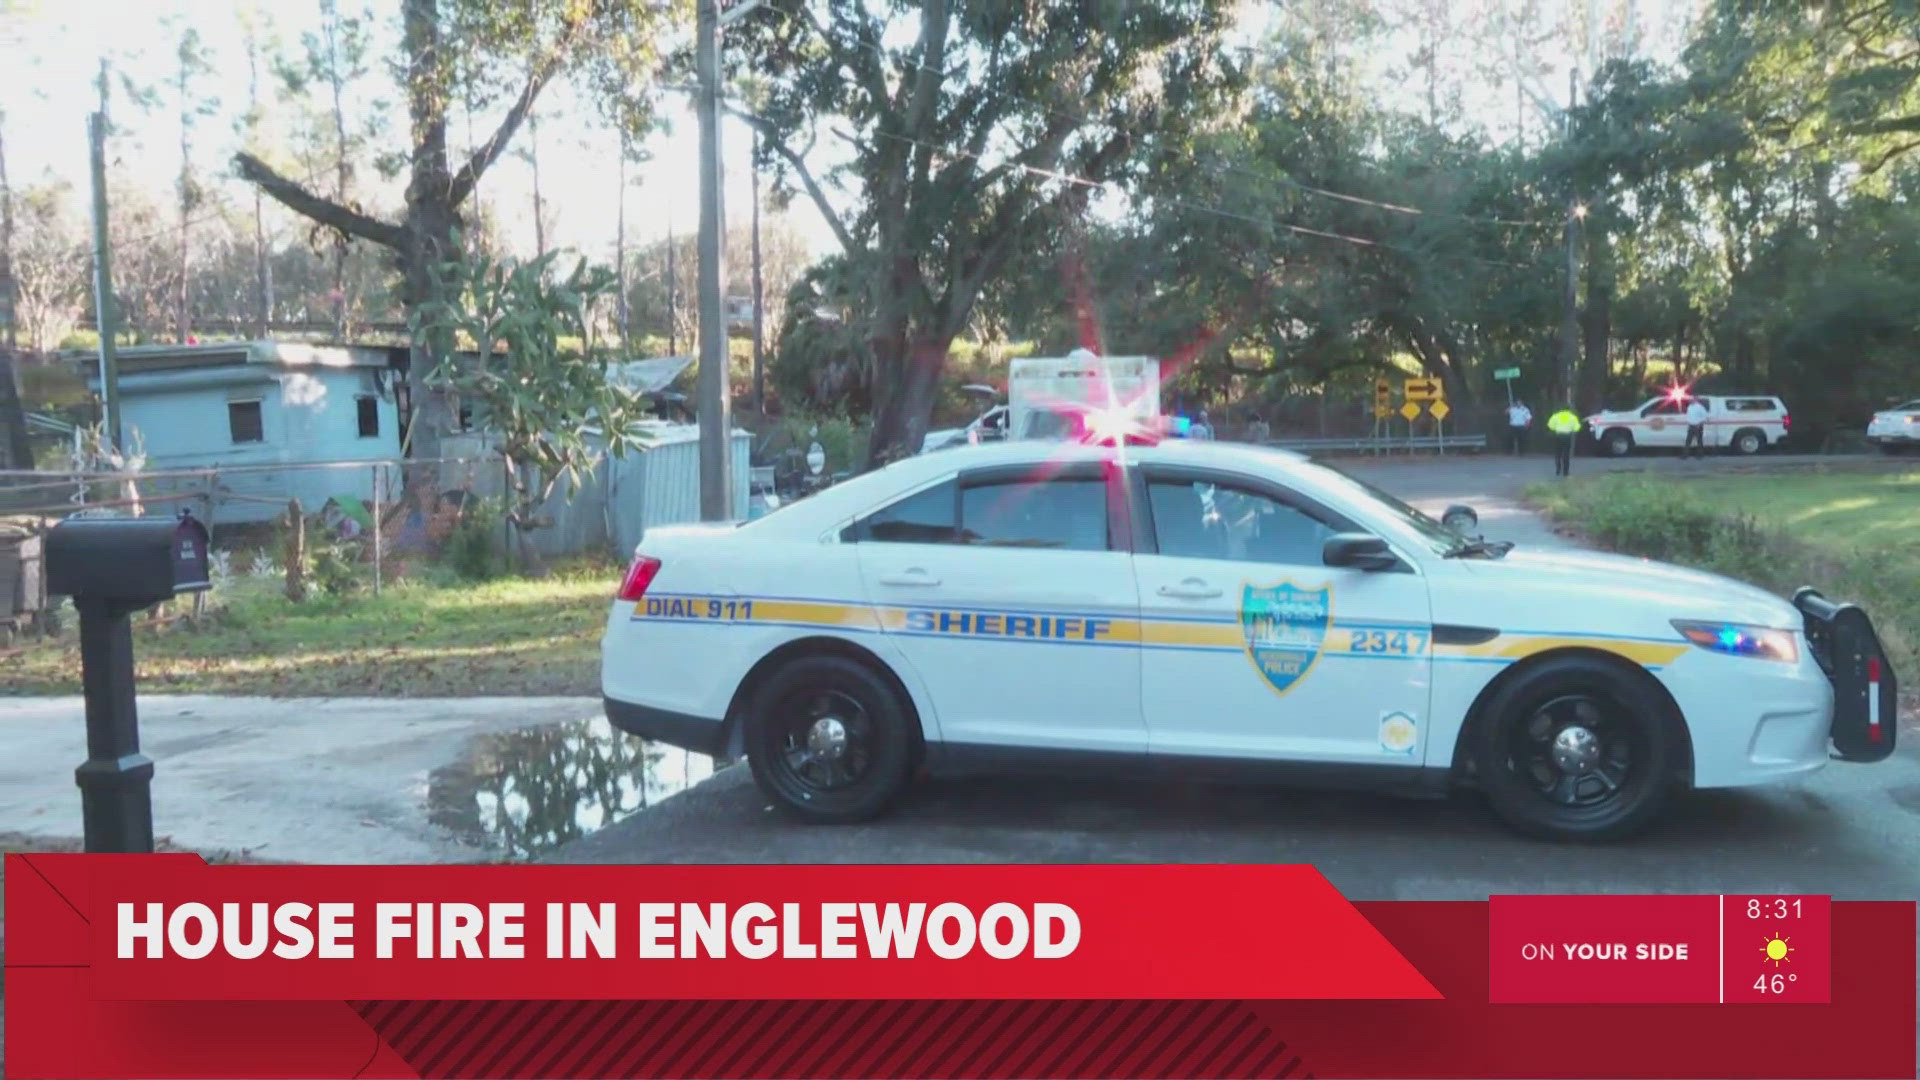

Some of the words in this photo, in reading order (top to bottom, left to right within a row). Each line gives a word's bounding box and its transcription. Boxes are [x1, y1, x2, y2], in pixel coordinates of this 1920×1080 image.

[647, 599, 699, 618] DIAL
[708, 600, 753, 620] 911
[905, 611, 1112, 640] SHERIFF
[1349, 630, 1430, 655] 2347
